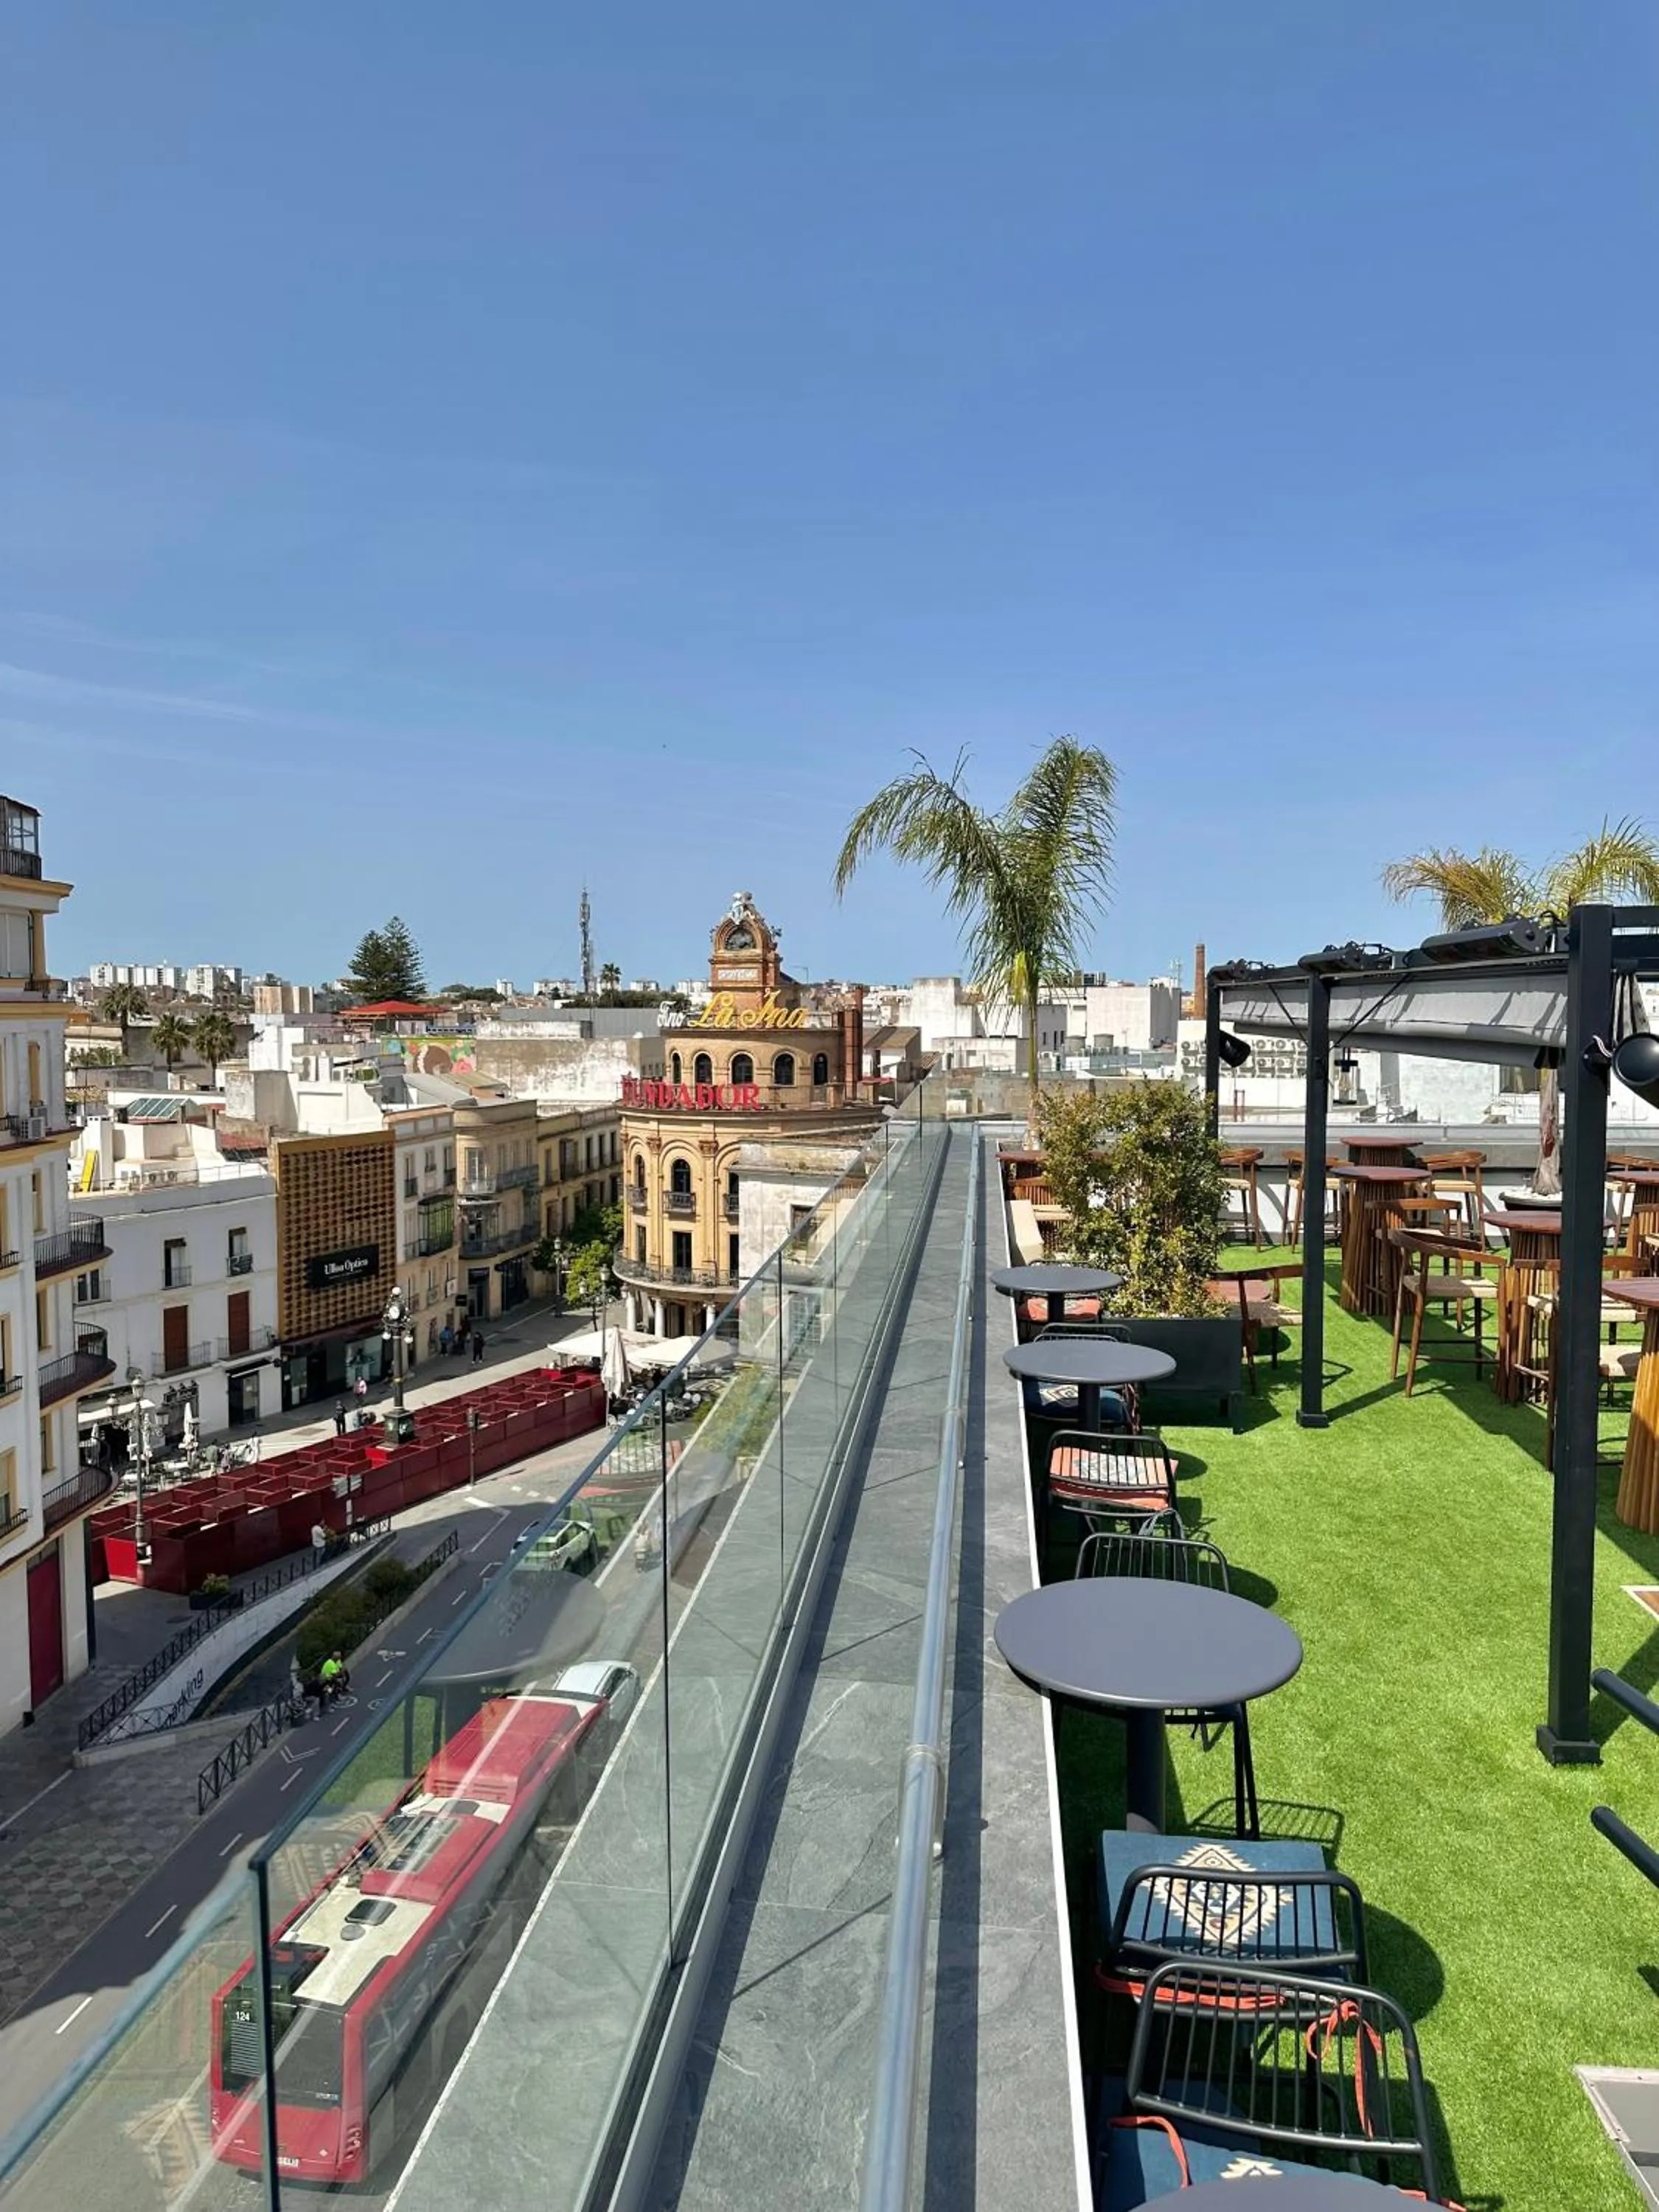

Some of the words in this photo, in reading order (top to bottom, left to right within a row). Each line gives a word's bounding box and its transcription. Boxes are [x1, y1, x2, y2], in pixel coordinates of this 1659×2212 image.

[687, 991, 734, 1028] La
[621, 1074, 761, 1110] FUNDADOR
[235, 2011, 251, 2021] 124
